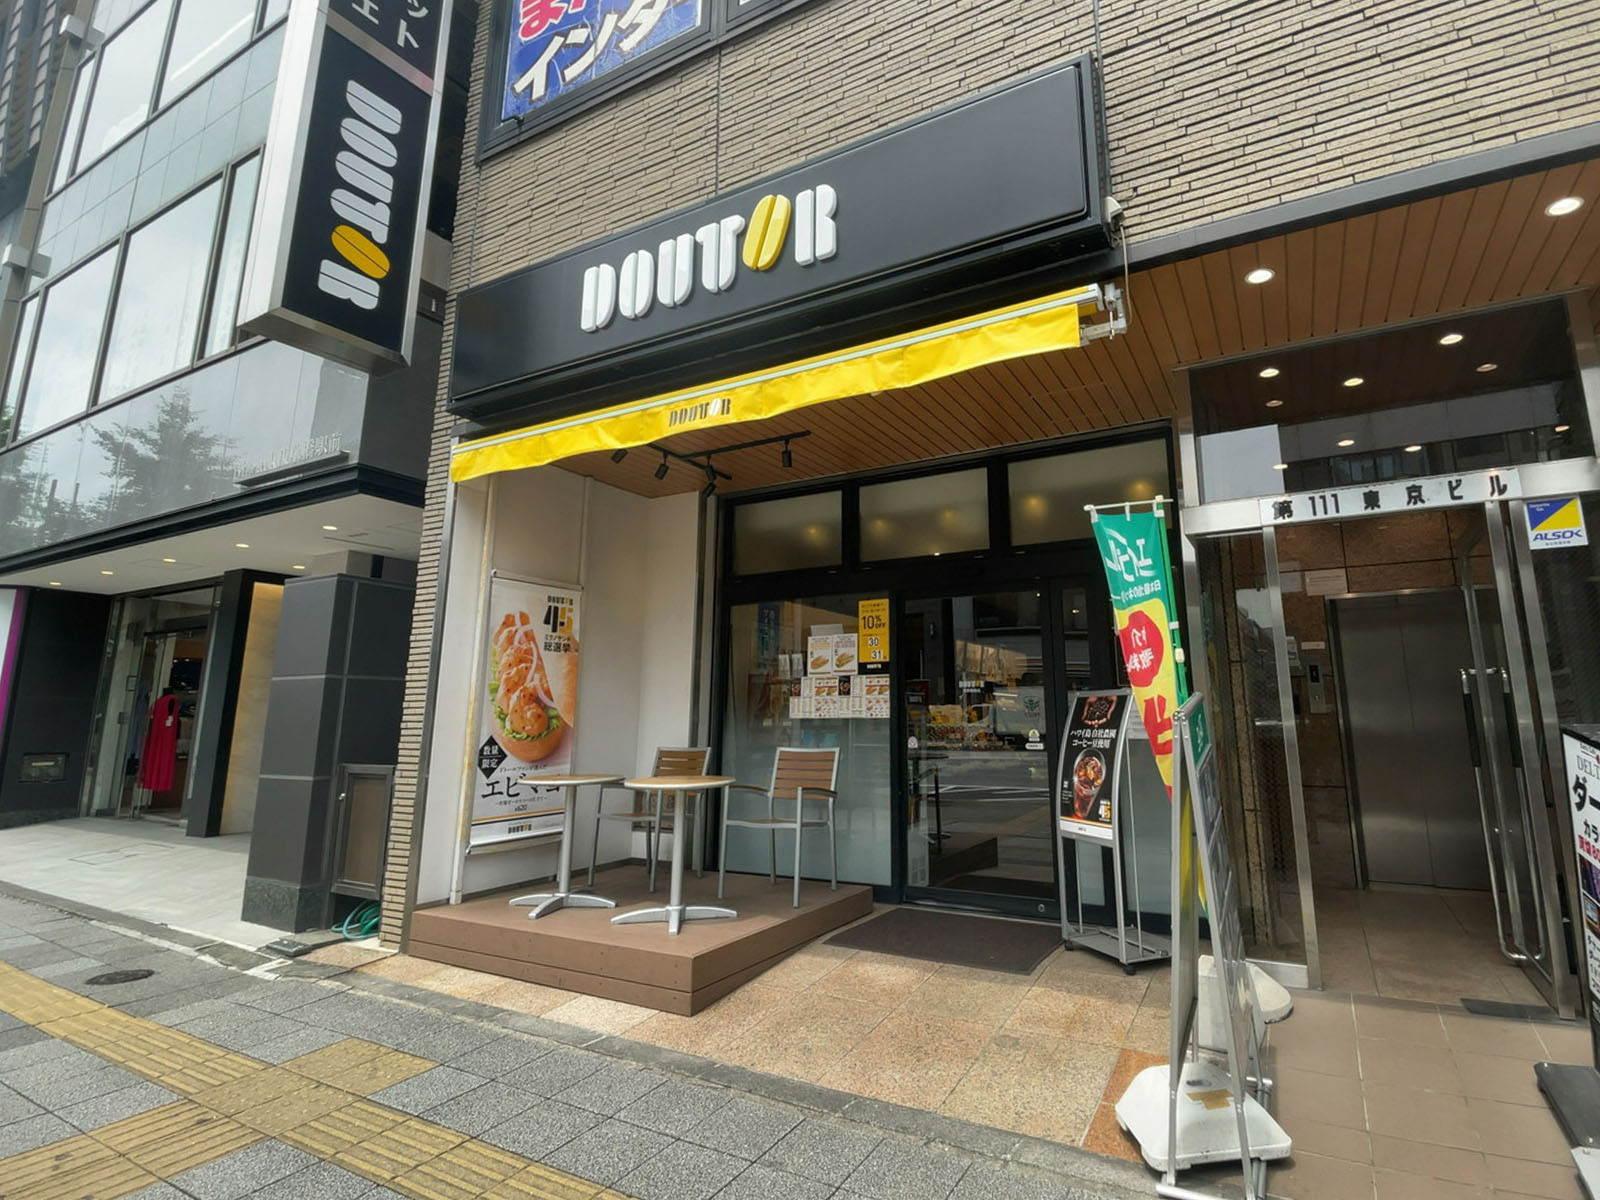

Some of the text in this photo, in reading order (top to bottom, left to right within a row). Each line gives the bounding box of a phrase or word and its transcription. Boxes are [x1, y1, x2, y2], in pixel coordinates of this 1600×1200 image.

[513, 0, 683, 100] インタ
[318, 79, 403, 310] DOUTOR
[581, 184, 837, 332] DOUTOR
[668, 398, 731, 427] DOUTOR
[1533, 529, 1583, 541] ALSOK
[543, 605, 574, 633] 45
